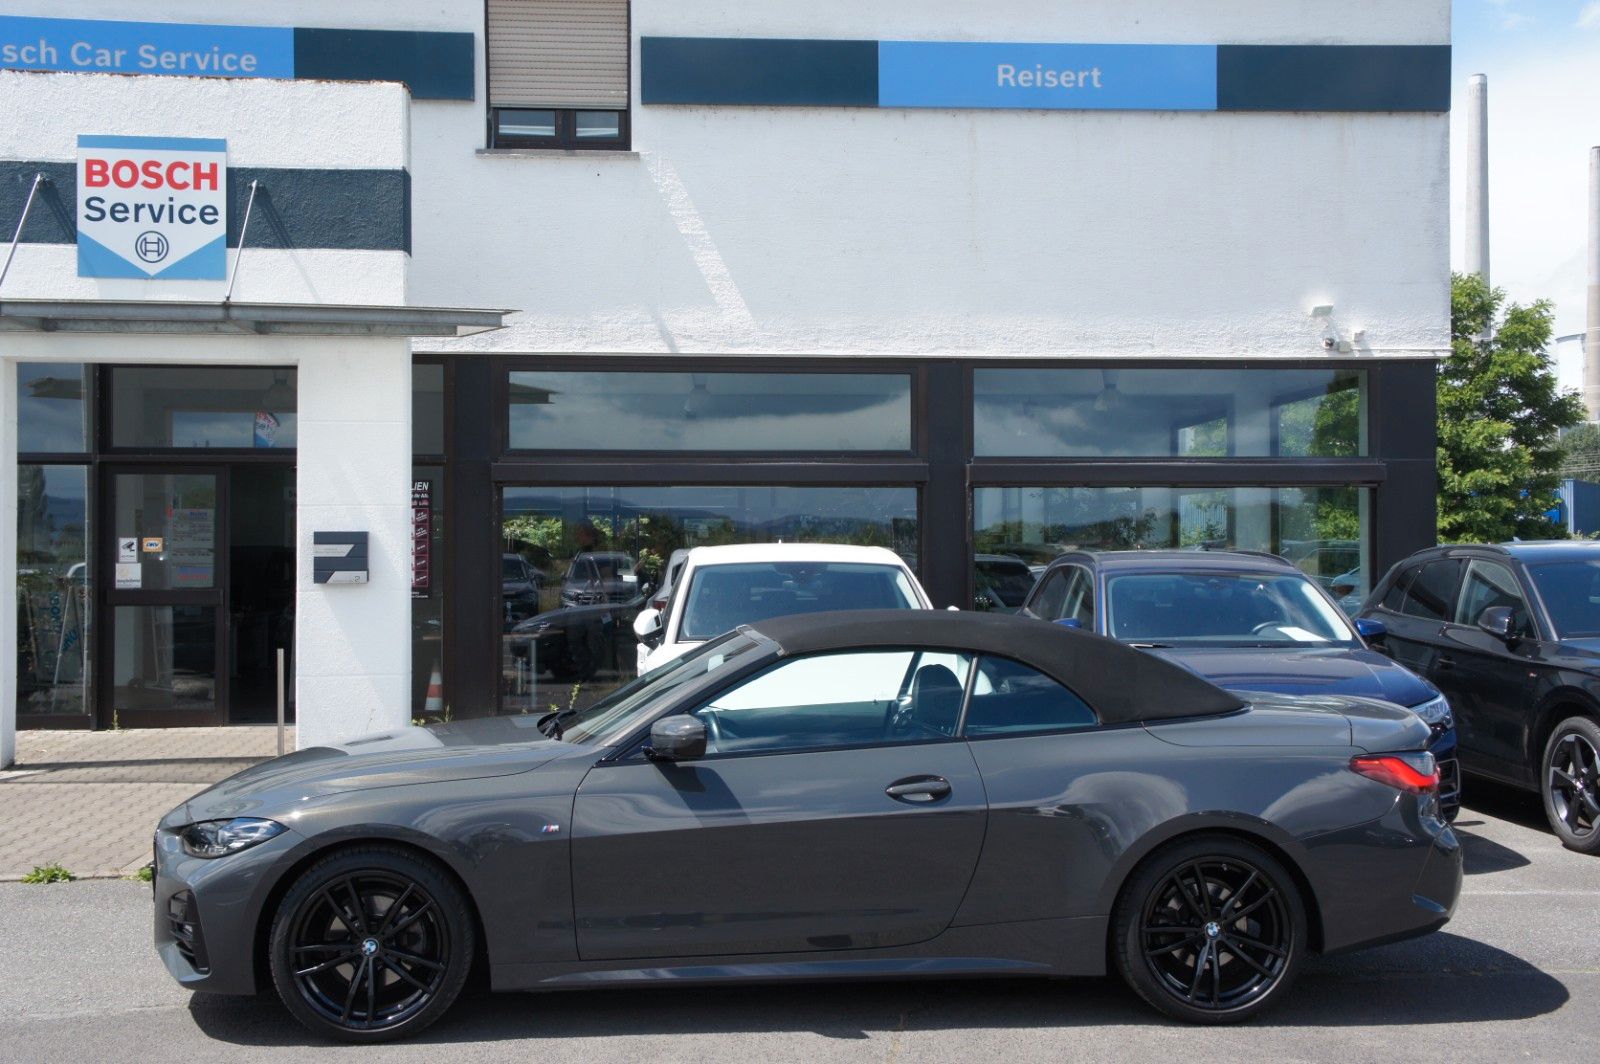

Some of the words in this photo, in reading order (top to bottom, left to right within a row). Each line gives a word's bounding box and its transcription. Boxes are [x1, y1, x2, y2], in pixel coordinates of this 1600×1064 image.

[2, 39, 58, 65] sch
[70, 41, 127, 68] Car
[138, 44, 258, 72] Service
[997, 63, 1103, 88] Reisert
[85, 158, 218, 191] BOSCH
[84, 196, 219, 225] Service
